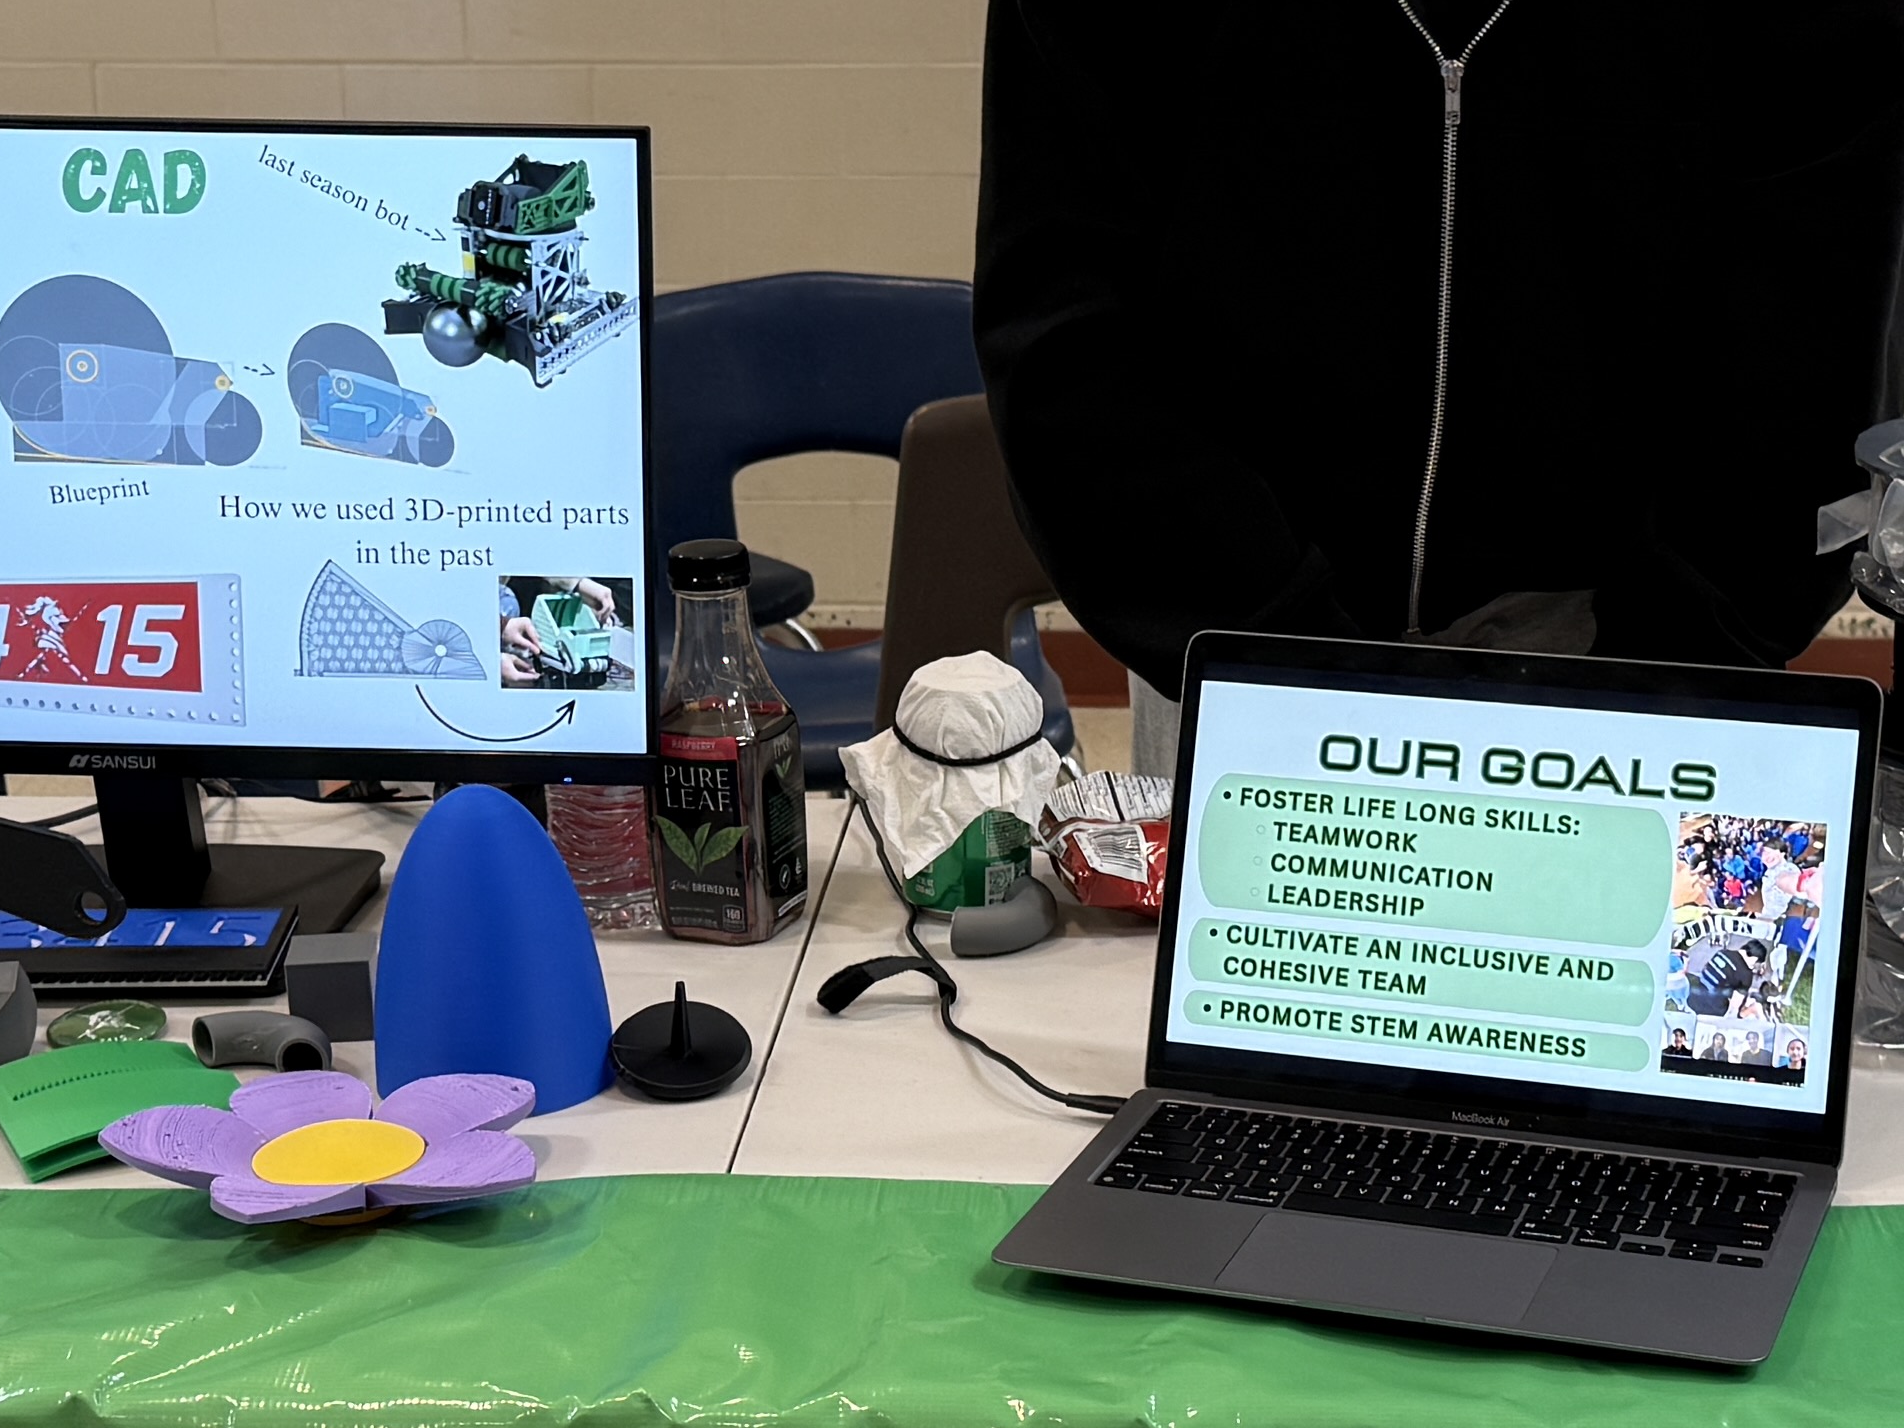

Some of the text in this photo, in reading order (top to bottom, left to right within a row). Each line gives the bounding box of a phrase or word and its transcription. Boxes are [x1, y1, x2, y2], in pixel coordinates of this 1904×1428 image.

[62, 147, 207, 215] CAD
[258, 144, 408, 230] last season bot
[48, 477, 150, 506] Blueprint
[219, 494, 629, 531] How we used 3D-printed parts
[356, 539, 494, 570] in the past
[94, 604, 187, 678] 15
[91, 755, 156, 769] SANSUI
[671, 739, 716, 751] RASPBERRY
[664, 764, 731, 790] PURE
[1319, 734, 1717, 802] OUR GOALS
[665, 787, 731, 812] LEAF
[1239, 787, 1581, 836] FOSTER LIFE LONG SKILLS:
[1273, 821, 1418, 854] TEAMWORK
[1270, 852, 1493, 893] COMMUNICATION
[1267, 883, 1425, 917] LEADERSHIP
[1226, 924, 1614, 981] CULTIVATE AN INCLUSIVE AND
[1223, 955, 1427, 996] COHESIVE TEAM
[1220, 999, 1586, 1058] PROMOTE STEM AWARENESS
[1451, 1111, 1510, 1127] MacBook Air
